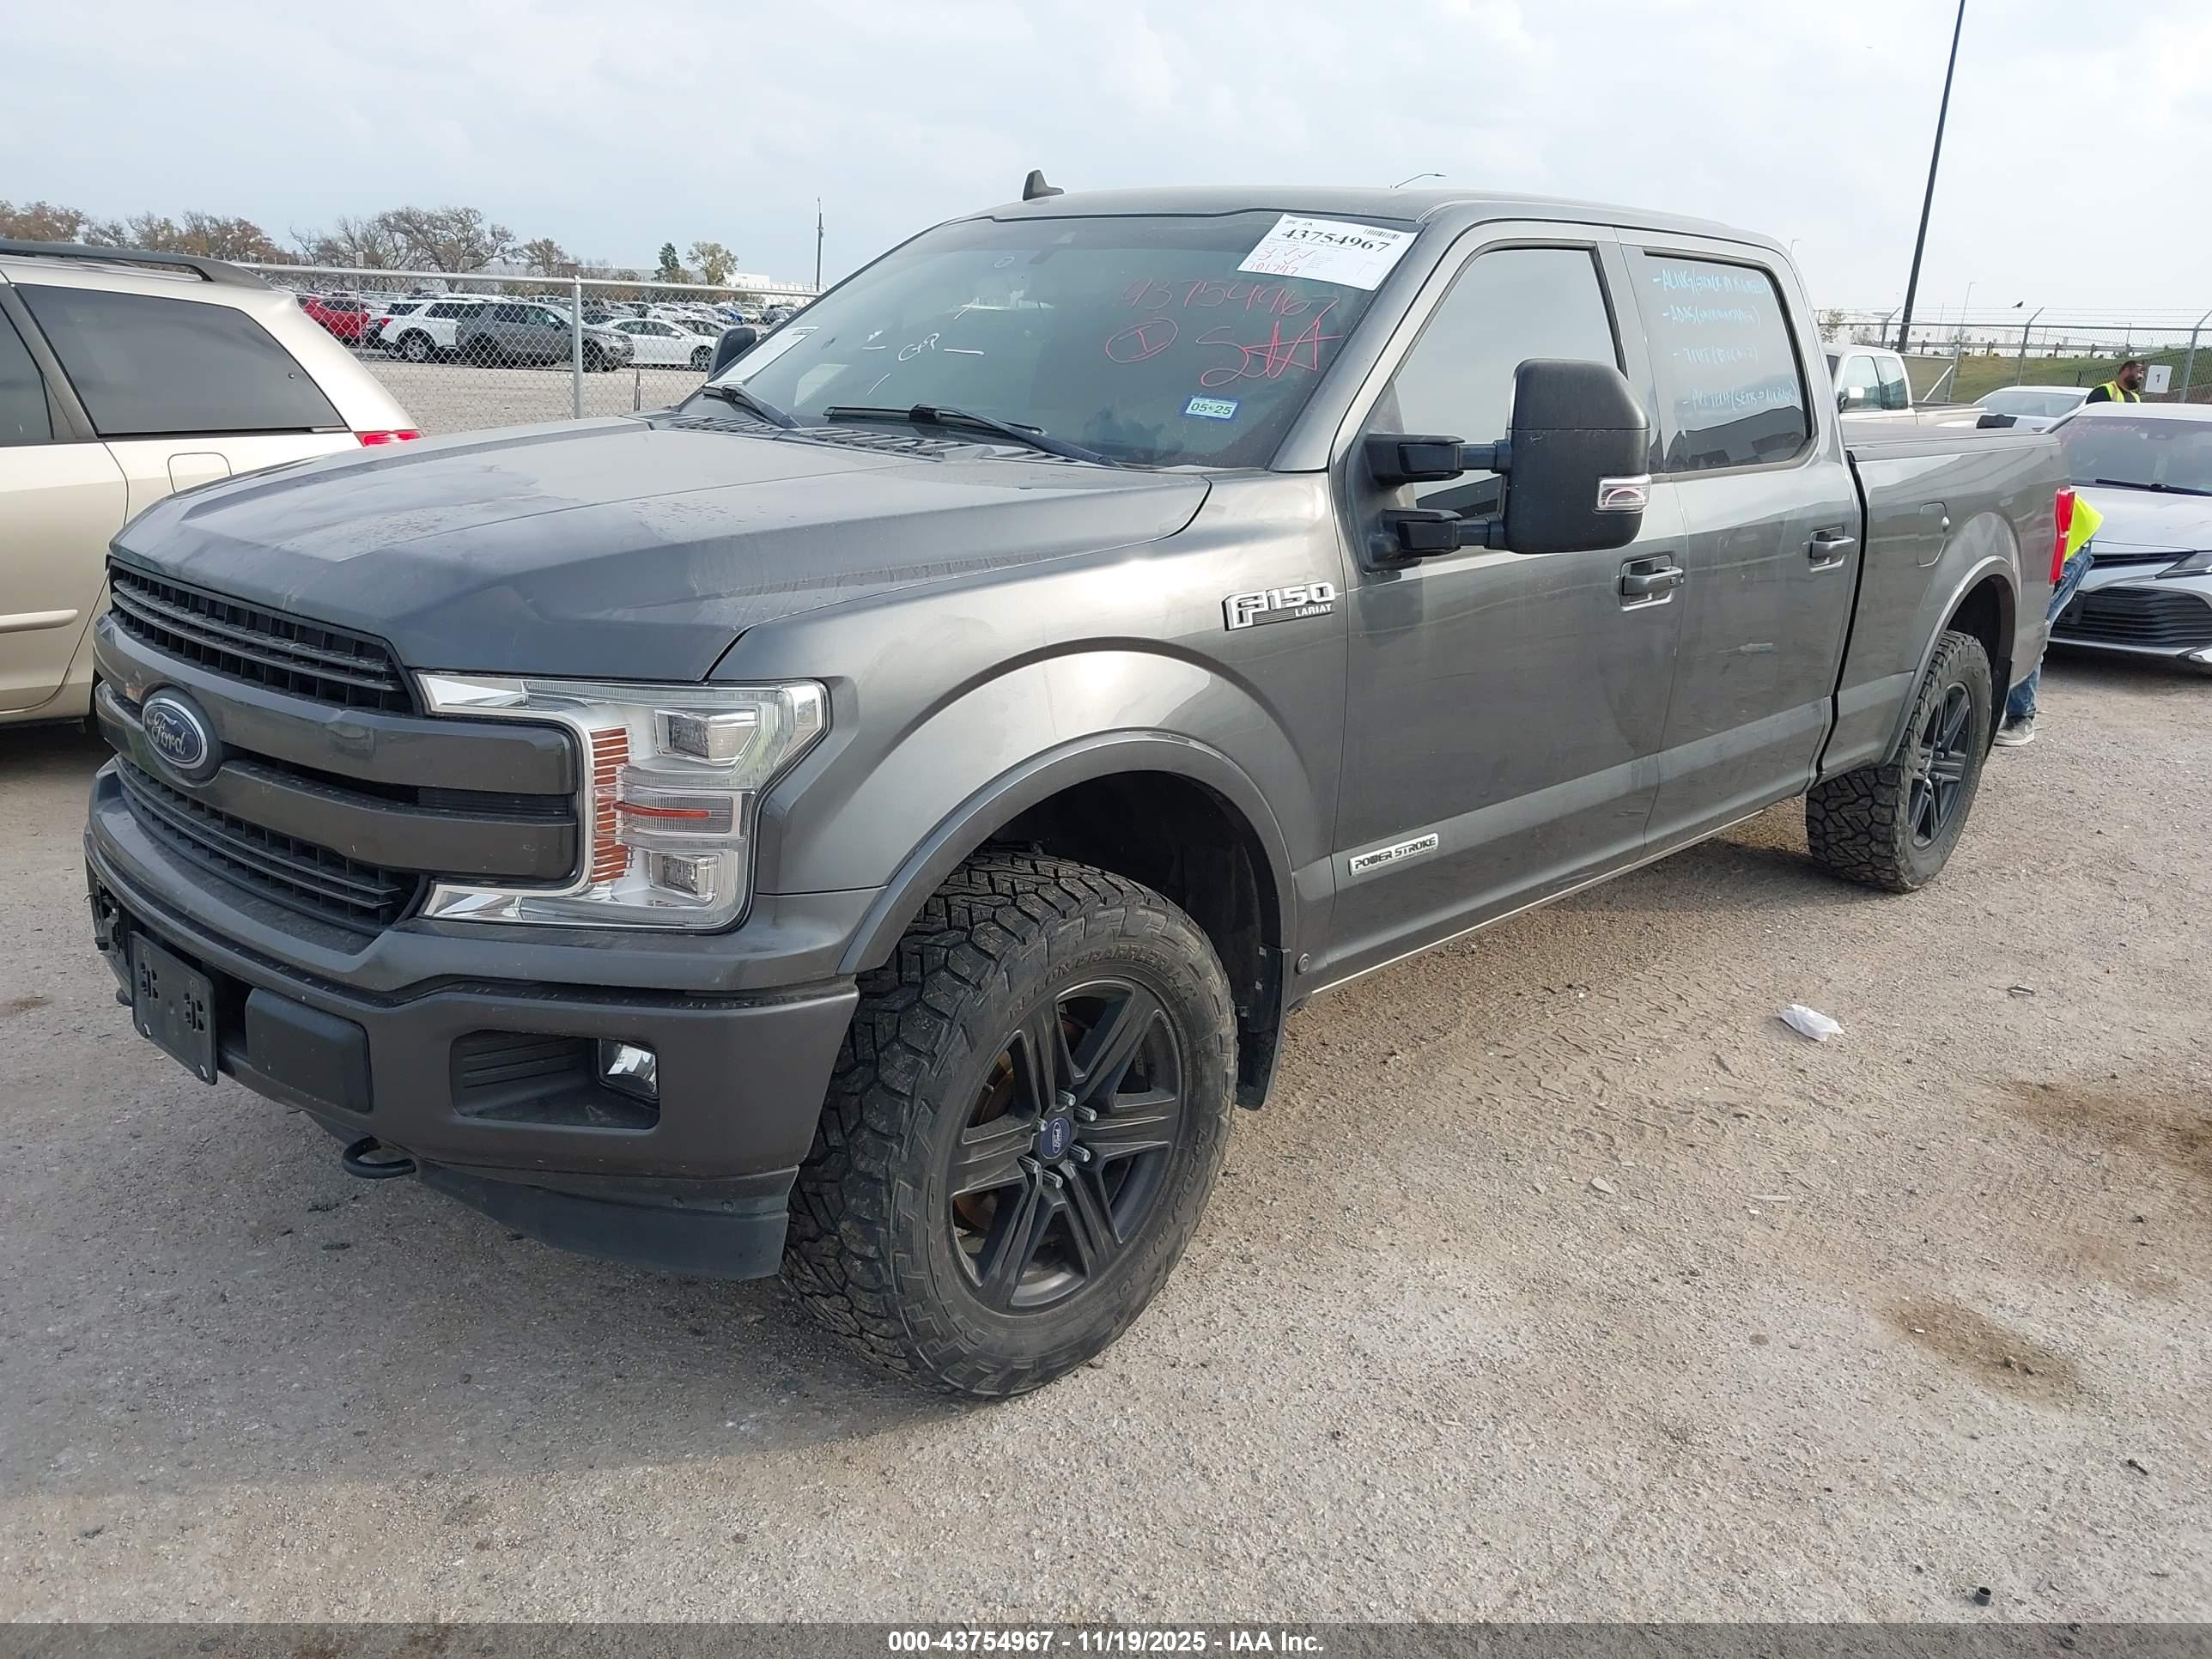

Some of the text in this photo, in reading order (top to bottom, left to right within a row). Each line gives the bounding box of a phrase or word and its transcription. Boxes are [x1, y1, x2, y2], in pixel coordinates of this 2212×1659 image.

[1280, 228, 1392, 252] 43754967
[2156, 374, 2161, 383] 1
[1294, 604, 1333, 617] LARIAT
[147, 711, 188, 756] Ford
[1354, 850, 1394, 870] POWER
[1395, 836, 1437, 858] STROKE
